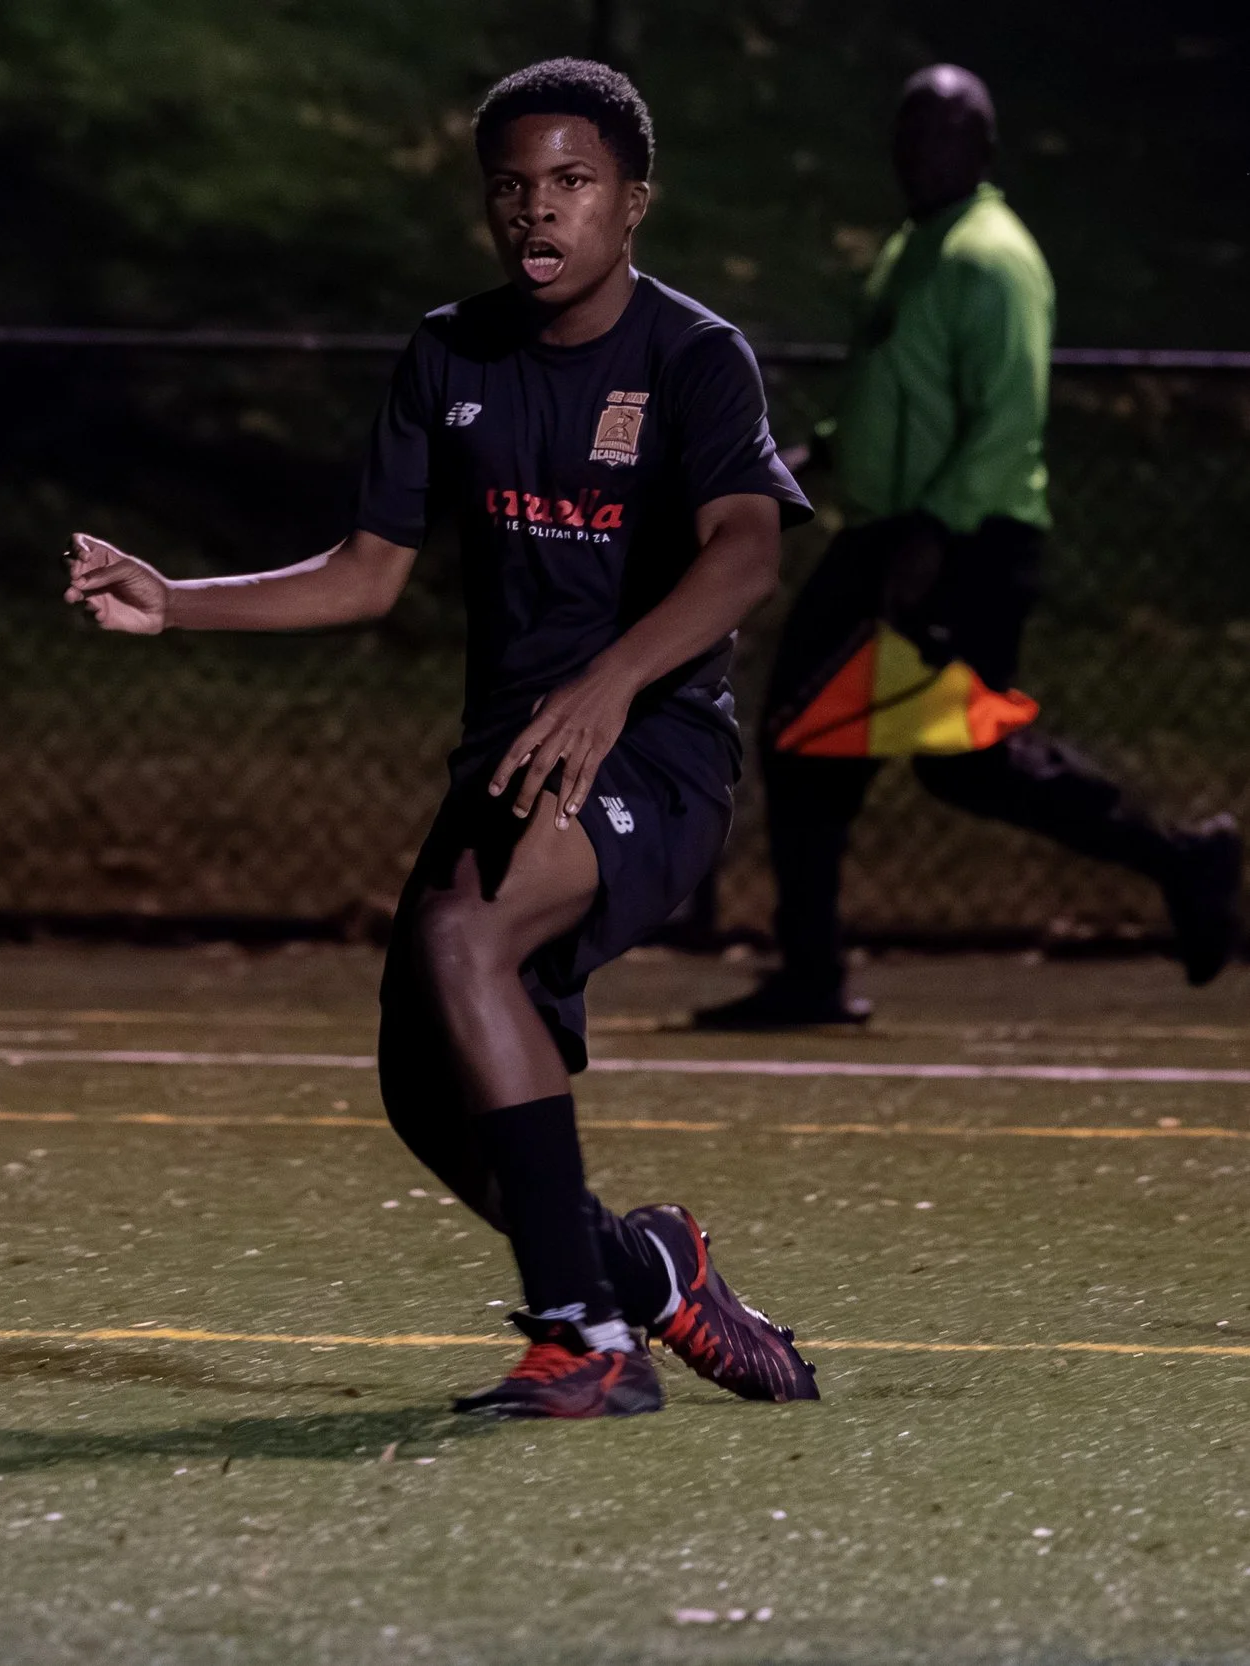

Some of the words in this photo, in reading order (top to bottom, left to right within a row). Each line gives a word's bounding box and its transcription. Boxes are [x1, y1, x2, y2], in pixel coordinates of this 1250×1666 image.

[589, 449, 638, 466] ACADEMY
[506, 520, 571, 540] EOLITAN
[576, 530, 611, 543] PIZA
